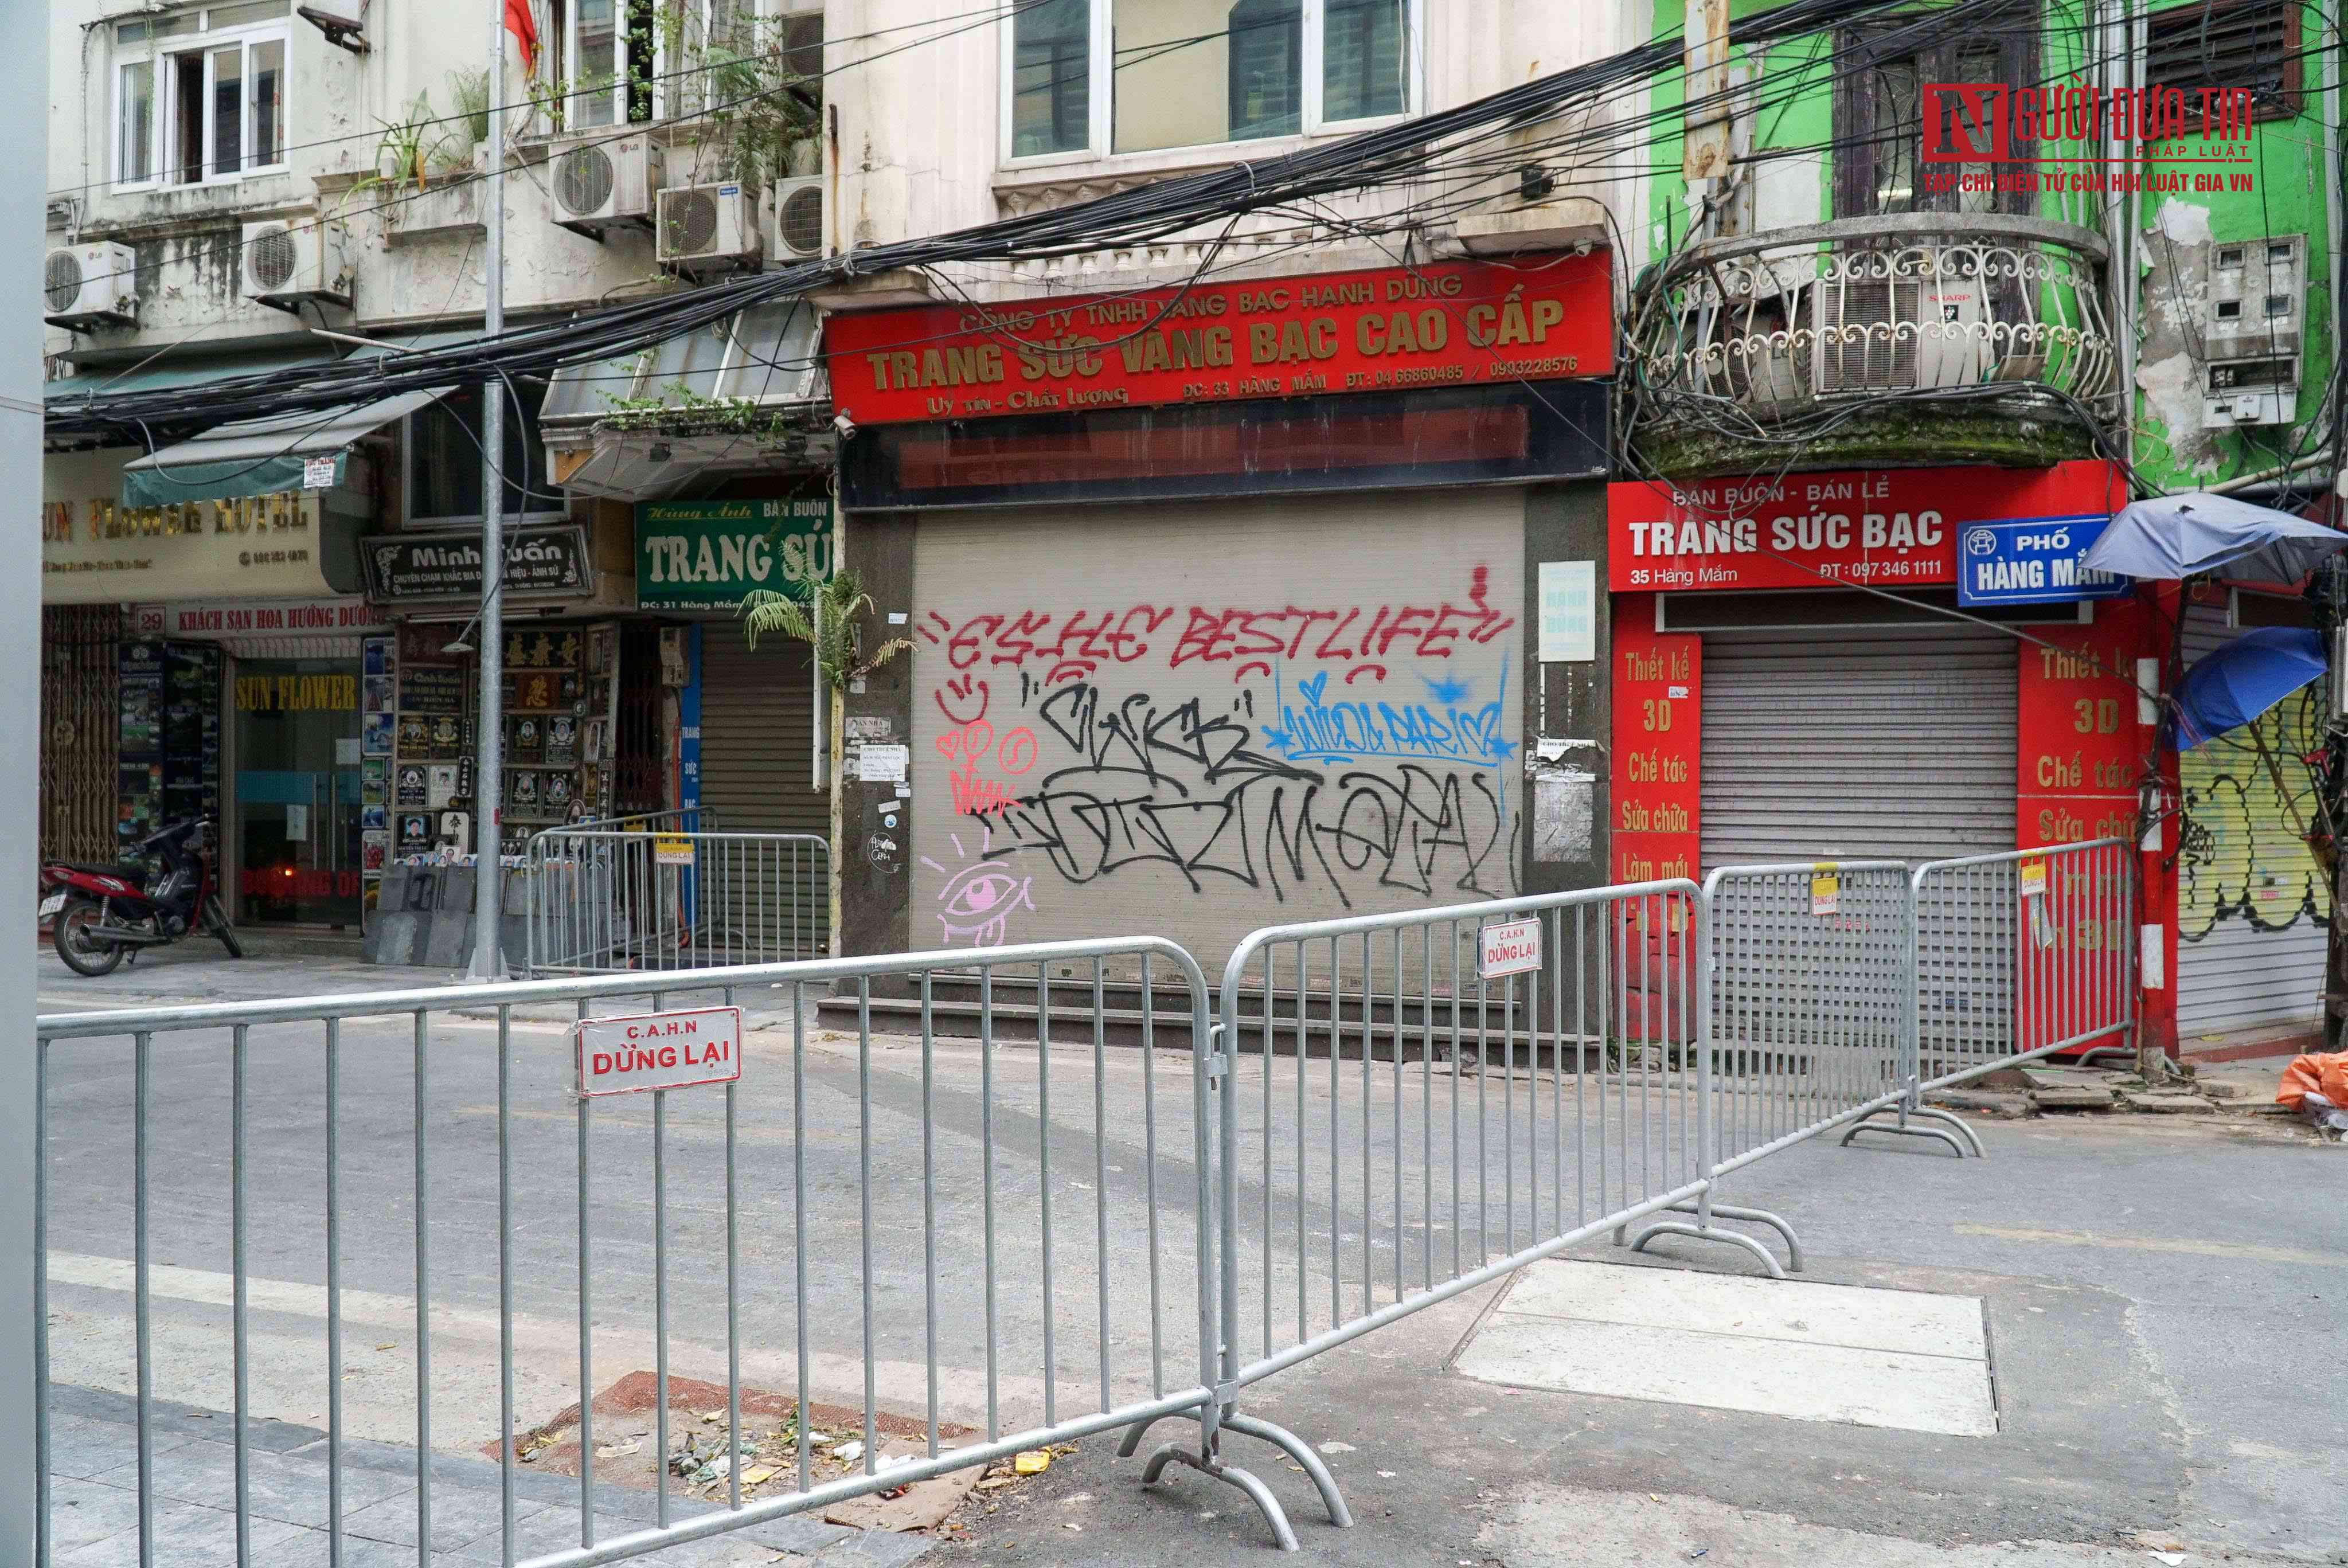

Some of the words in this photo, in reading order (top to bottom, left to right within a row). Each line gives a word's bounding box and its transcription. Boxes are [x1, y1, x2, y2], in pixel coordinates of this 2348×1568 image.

[959, 306, 1035, 333] CÔNG
[1046, 308, 1073, 330] TY
[1085, 300, 1147, 326] TNHH
[1239, 288, 1290, 314] BẠC
[1301, 284, 1375, 310] HẠNH
[866, 343, 1005, 391] TRANG
[1020, 326, 1103, 382] SỨC
[1118, 323, 1233, 374] VÀNG
[1249, 316, 1339, 366] BẠC
[1355, 307, 1448, 357] CAO
[1467, 282, 1565, 348] CẤP
[1213, 380, 1230, 396] 33
[1376, 369, 1392, 385] 04
[1394, 362, 1464, 384] 66860485
[1724, 483, 1786, 505] BUÔN
[1807, 479, 1853, 501] BÁN
[1862, 475, 1890, 499] LẺ
[794, 499, 827, 517] BUÔN
[1628, 517, 1757, 557] TRANG
[1771, 503, 1851, 552] SỨC
[1862, 510, 1943, 555] BẠC
[2016, 526, 2070, 552] PHỐ
[411, 545, 481, 568] Minh
[502, 537, 562, 562] uấn
[645, 534, 773, 582] TRANG
[780, 518, 833, 581] SỨ
[1630, 569, 1650, 584] 35
[1654, 565, 1694, 586] Hàng
[1699, 563, 1738, 582] Mắm
[1851, 562, 1880, 578] 097
[1881, 560, 1910, 576] 346
[1913, 558, 1942, 575] 1111
[1978, 555, 2045, 591] HÀNG
[141, 613, 162, 630] 29
[178, 607, 222, 631] KHÁCH
[226, 609, 252, 632] SẠN
[256, 608, 283, 629] HOA
[287, 603, 334, 628] HƯỚNG
[641, 601, 661, 609] ĐC:
[663, 601, 677, 609] 31
[681, 600, 710, 610] Hàng
[1625, 646, 1664, 682] Thiết
[1671, 645, 1690, 681] kế
[2040, 642, 2101, 679] Thiết
[235, 675, 272, 711] SUN
[278, 674, 358, 711] FLOWER
[1643, 698, 1672, 732] 3D
[2073, 698, 2121, 734] 3D
[682, 726, 700, 739] TRANG
[685, 759, 697, 775] SỨC
[1628, 748, 1658, 783] Chế
[1663, 753, 1689, 783] tác
[2037, 750, 2083, 788] Chế
[2094, 756, 2135, 789] tác
[1622, 799, 1649, 832] Sửa
[1652, 802, 1689, 831] chữa
[2038, 807, 2084, 842] Sửa
[2095, 811, 2138, 843] chữ
[1623, 853, 1652, 882] Làm
[1661, 853, 1689, 879] mới
[1499, 928, 1525, 940] C.A.H.N
[1488, 943, 1517, 964] DỪNG
[1519, 941, 1536, 960] LẠI
[627, 1019, 698, 1040] C.A.H.N
[592, 1042, 677, 1075] DỪNG
[684, 1039, 730, 1069] LẠI
